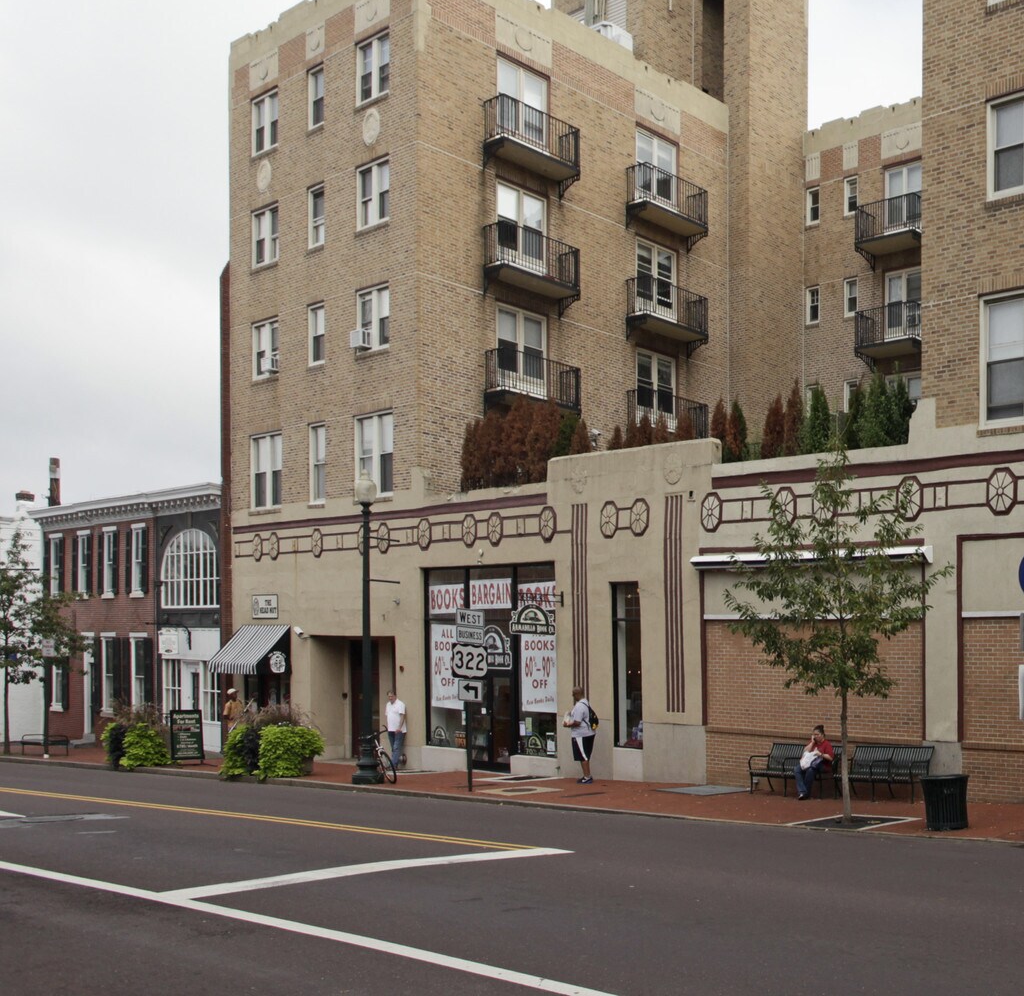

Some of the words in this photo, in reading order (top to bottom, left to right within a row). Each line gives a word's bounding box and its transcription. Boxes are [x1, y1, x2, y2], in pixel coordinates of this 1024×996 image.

[430, 588, 465, 610] BOOKS
[471, 583, 512, 605] BARGAIN
[459, 611, 481, 624] WEST
[441, 629, 454, 639] ALL
[458, 629, 483, 641] BUSINESS
[434, 641, 452, 651] BOO
[524, 640, 555, 651] BOOKS
[455, 650, 484, 671] 322
[440, 678, 456, 687] OFF
[531, 679, 548, 689] OFF
